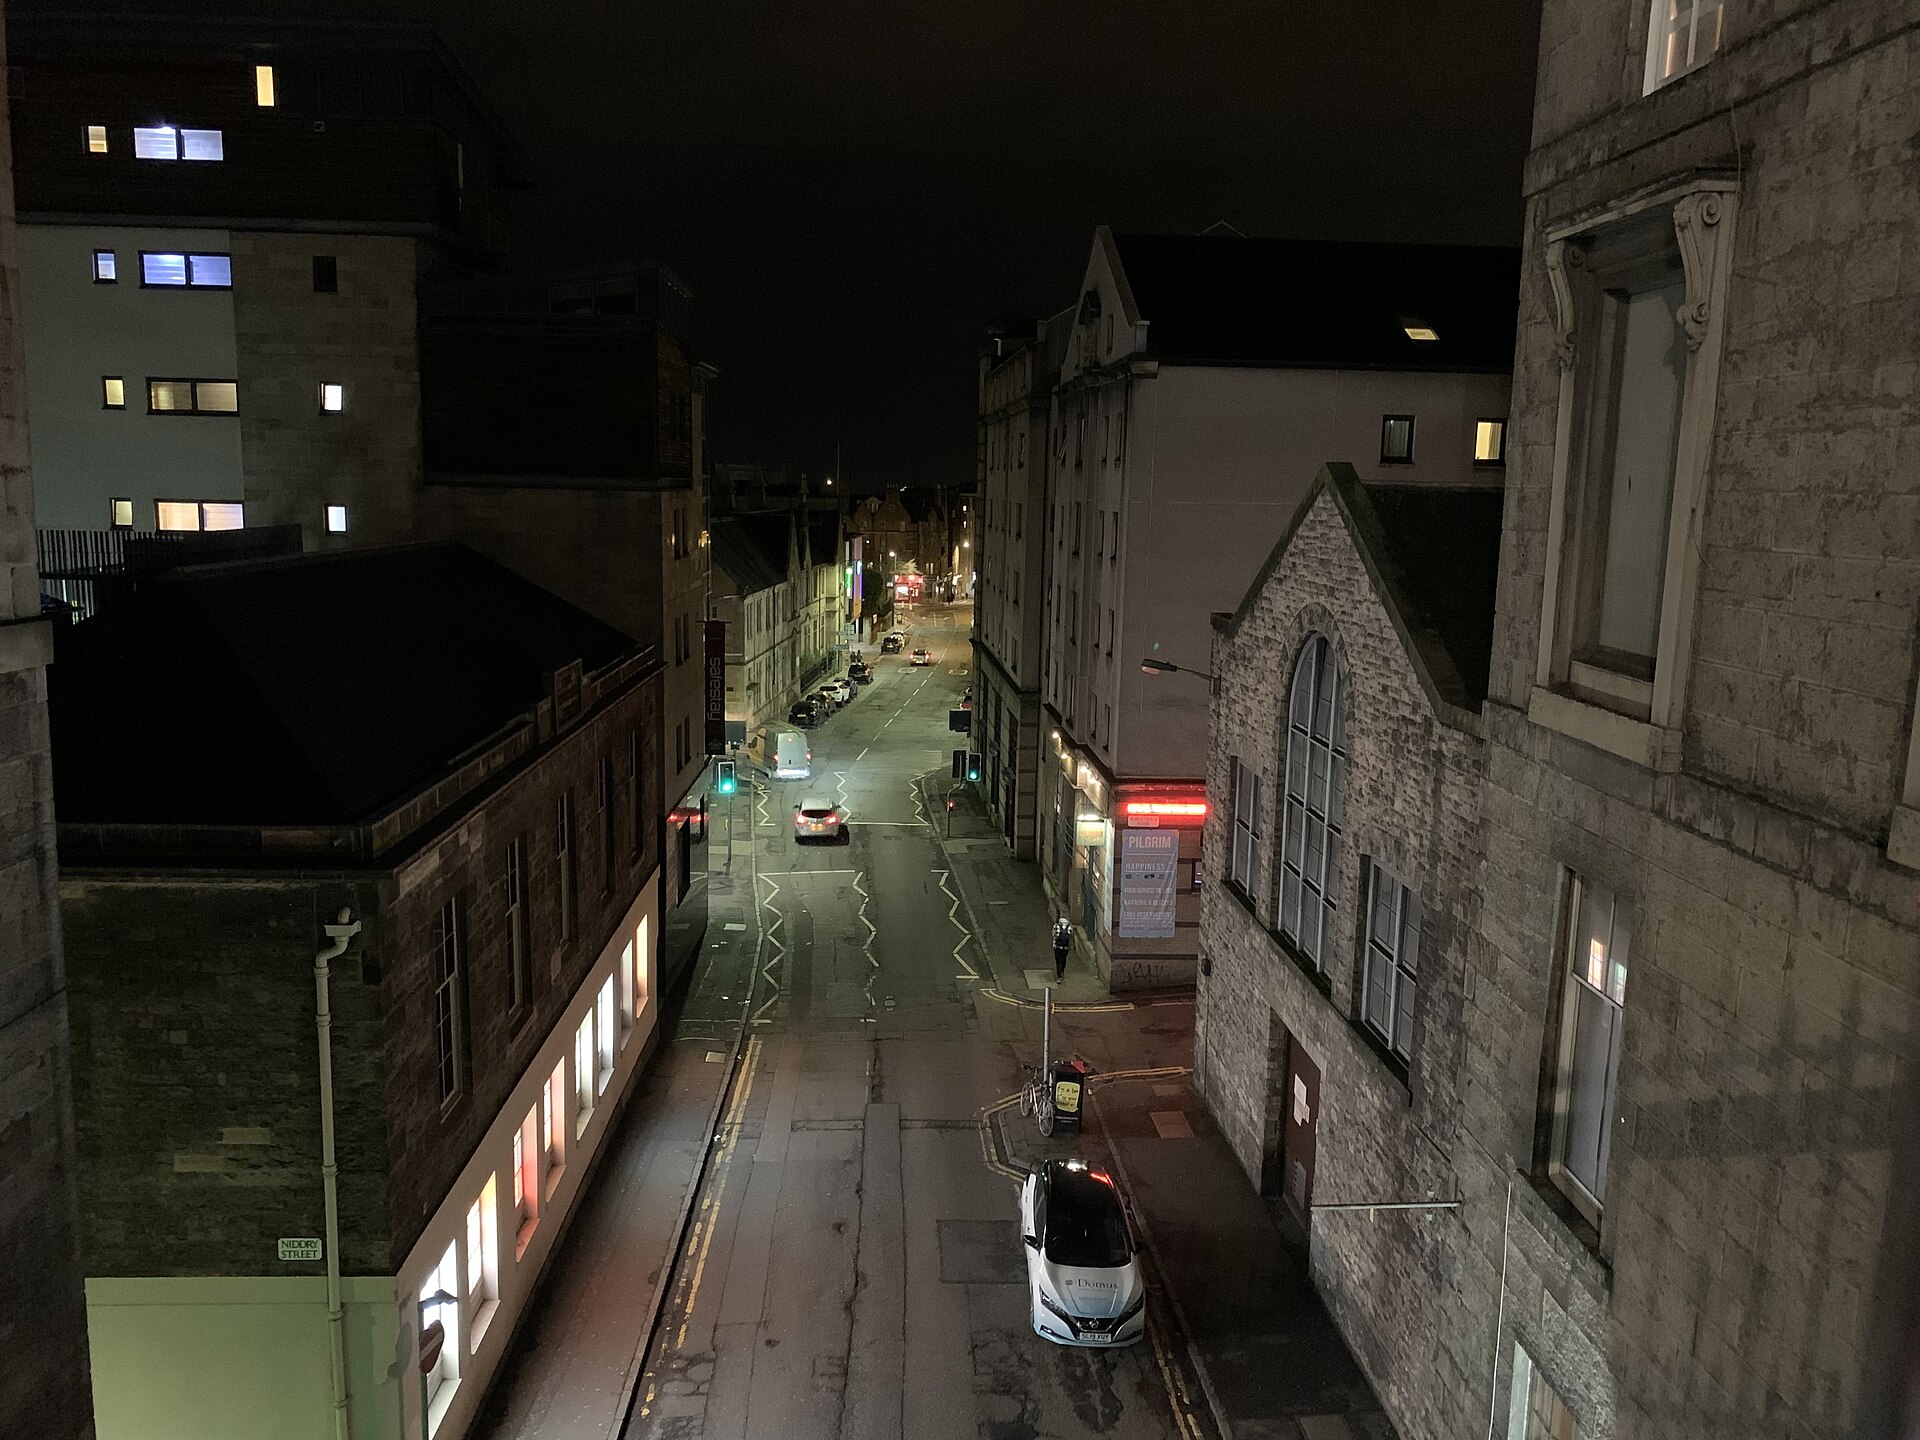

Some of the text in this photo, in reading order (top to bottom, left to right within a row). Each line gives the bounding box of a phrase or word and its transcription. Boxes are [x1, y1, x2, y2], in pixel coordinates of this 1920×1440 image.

[707, 657, 722, 721] safestay
[1128, 836, 1171, 848] PILGRIM
[1125, 862, 1166, 871] HAPPINESS
[281, 1240, 318, 1248] NIDDRY
[281, 1250, 318, 1258] STREET
[1078, 1279, 1119, 1289] Domus
